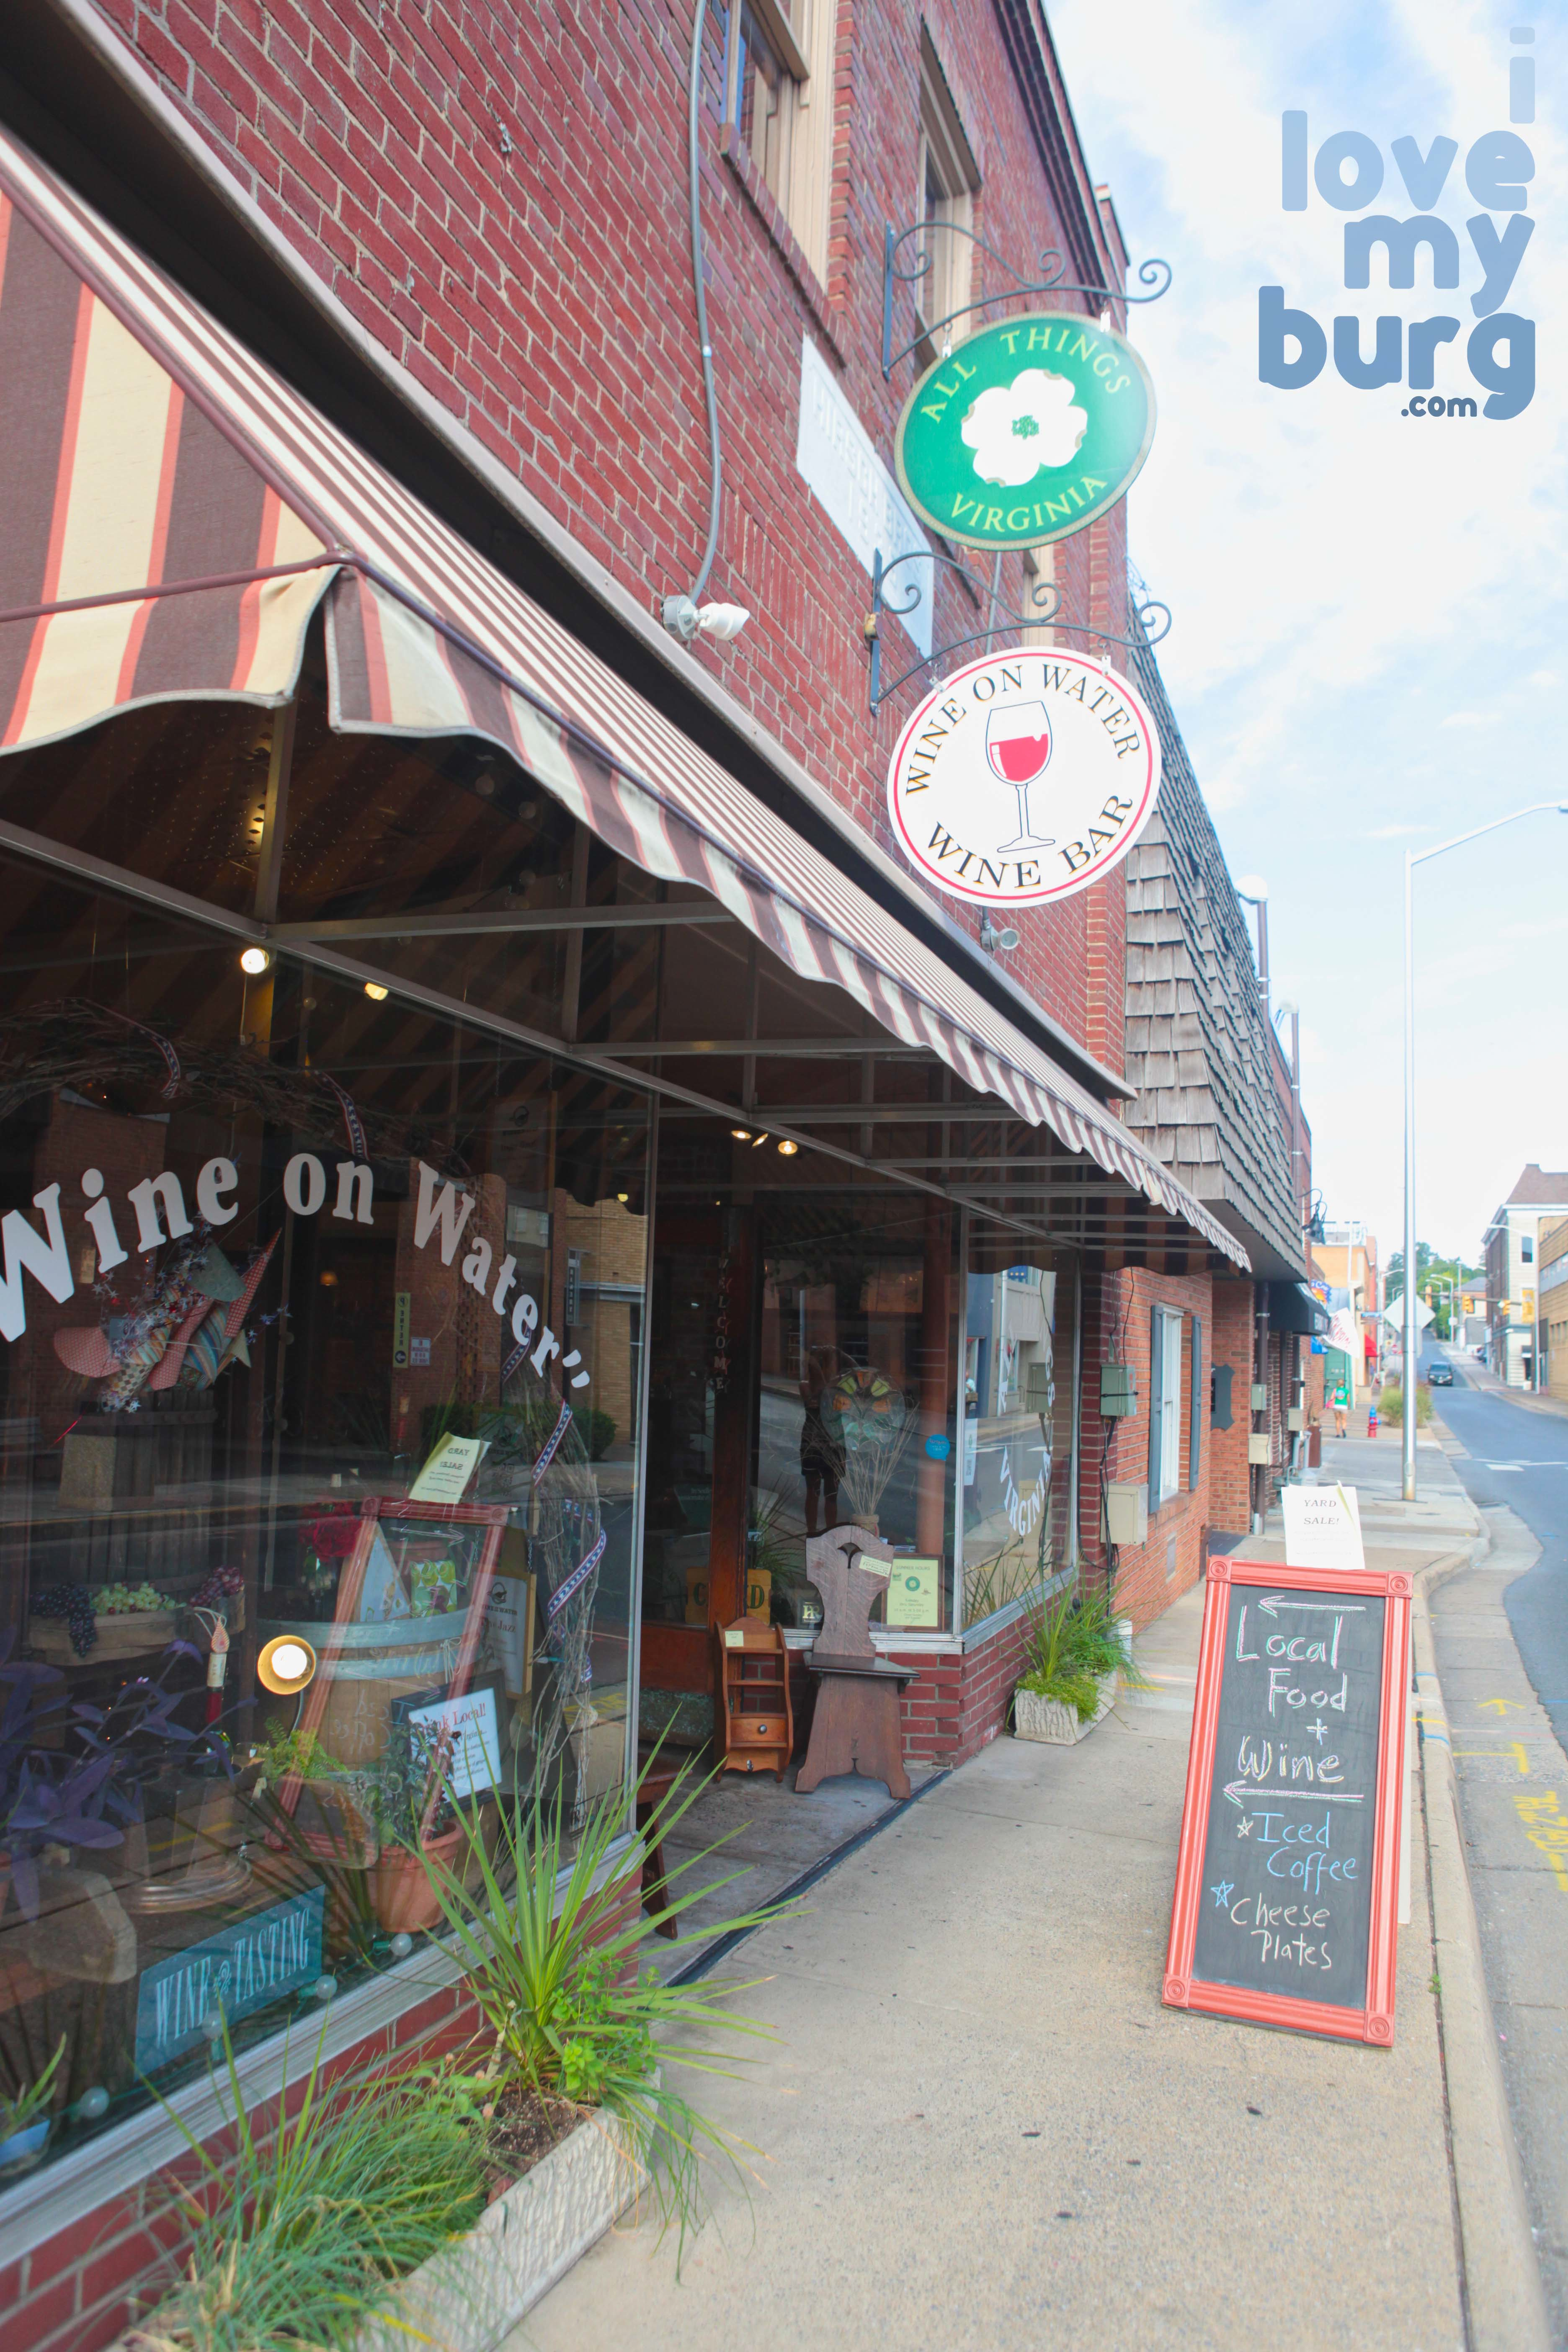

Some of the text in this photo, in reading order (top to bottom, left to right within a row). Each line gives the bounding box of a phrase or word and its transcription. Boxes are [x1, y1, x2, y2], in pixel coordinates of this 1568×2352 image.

[921, 327, 1131, 424] ALL THINGS
[951, 475, 1108, 533] VIRGINIA
[905, 663, 1140, 796] WINE ON WATER
[928, 795, 1133, 889] WINE BAR
[0, 1157, 239, 1342] Wine
[284, 1153, 374, 1225] on
[1000, 1445, 1051, 1536] VIRGINIA
[1236, 1605, 1343, 1670] Local
[1268, 1667, 1347, 1718] Food
[1238, 1735, 1344, 1782] Wine
[1251, 1811, 1330, 1849] Iced
[1266, 1846, 1358, 1895] Coffee
[1230, 1892, 1331, 1928] Cheese
[156, 1907, 312, 2050] WINE TASTING
[1250, 1929, 1332, 1970] Plates
